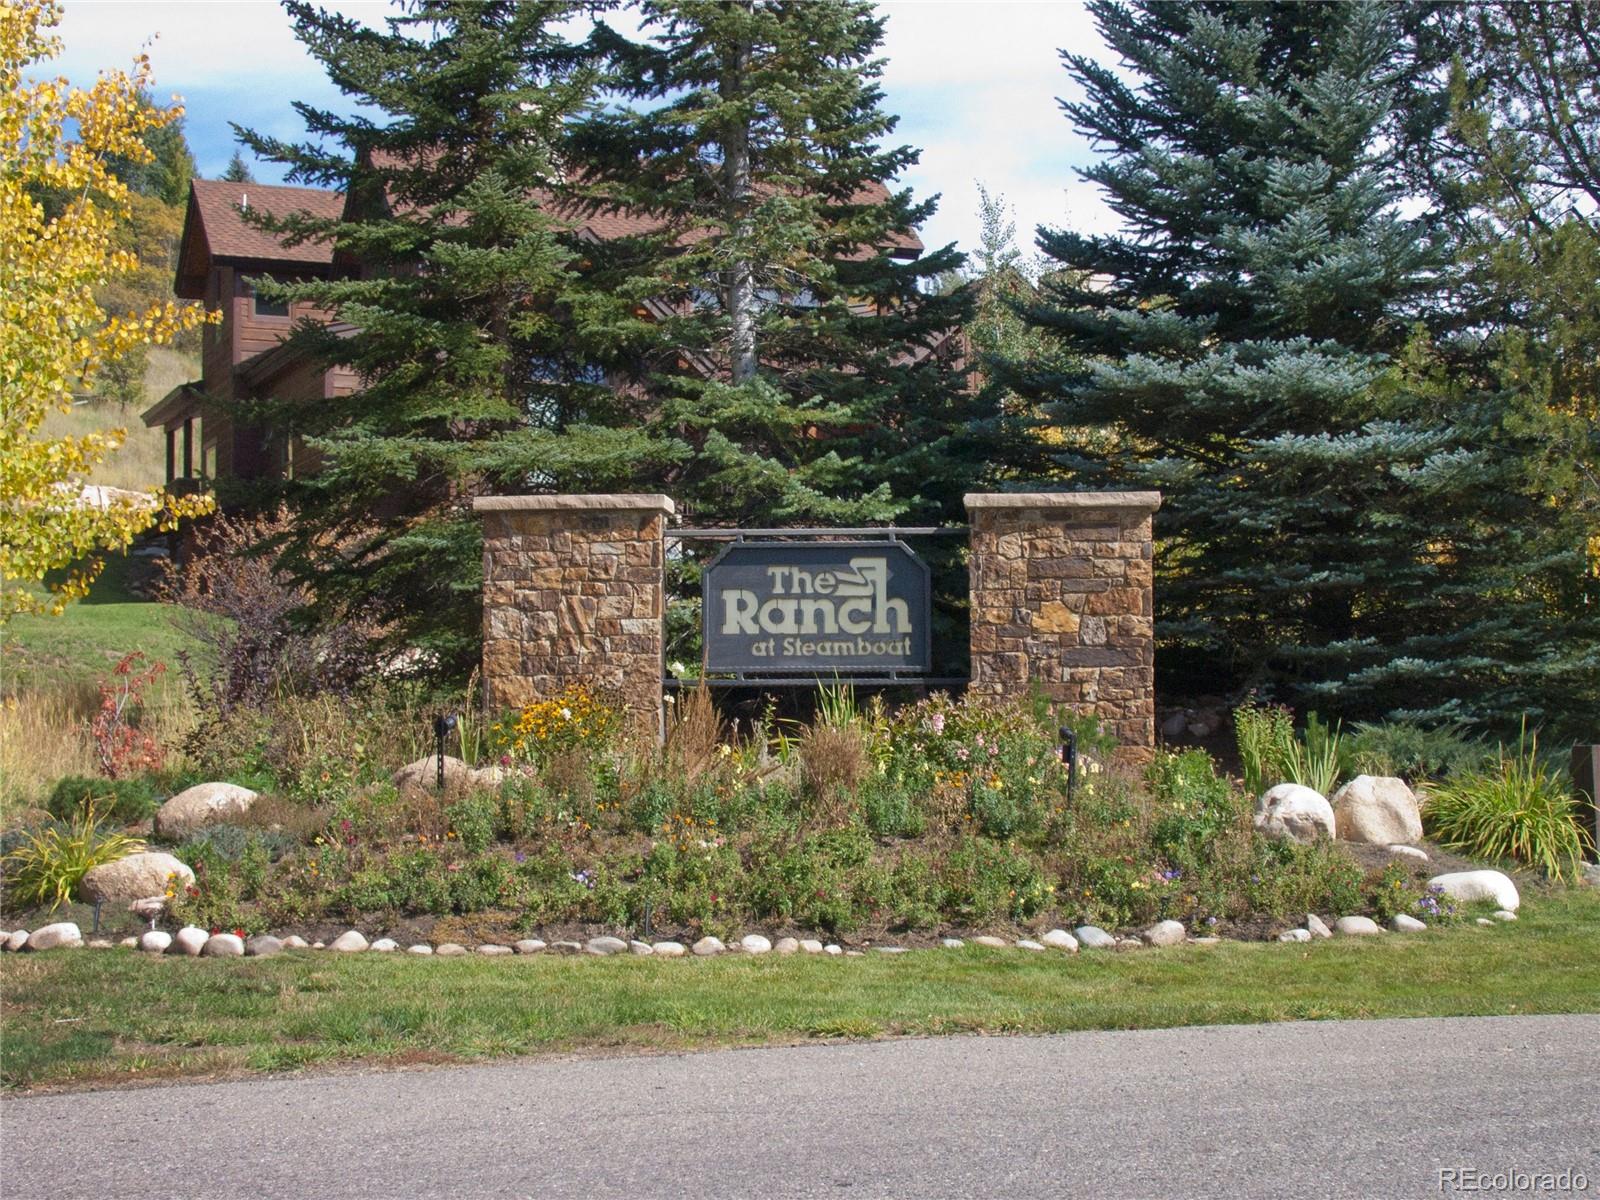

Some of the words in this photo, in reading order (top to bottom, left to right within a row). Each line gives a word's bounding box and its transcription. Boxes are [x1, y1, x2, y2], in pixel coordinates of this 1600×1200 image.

[767, 565, 837, 594] The
[721, 557, 913, 635] Ranch
[751, 638, 775, 657] at
[783, 637, 912, 656] Steamboat
